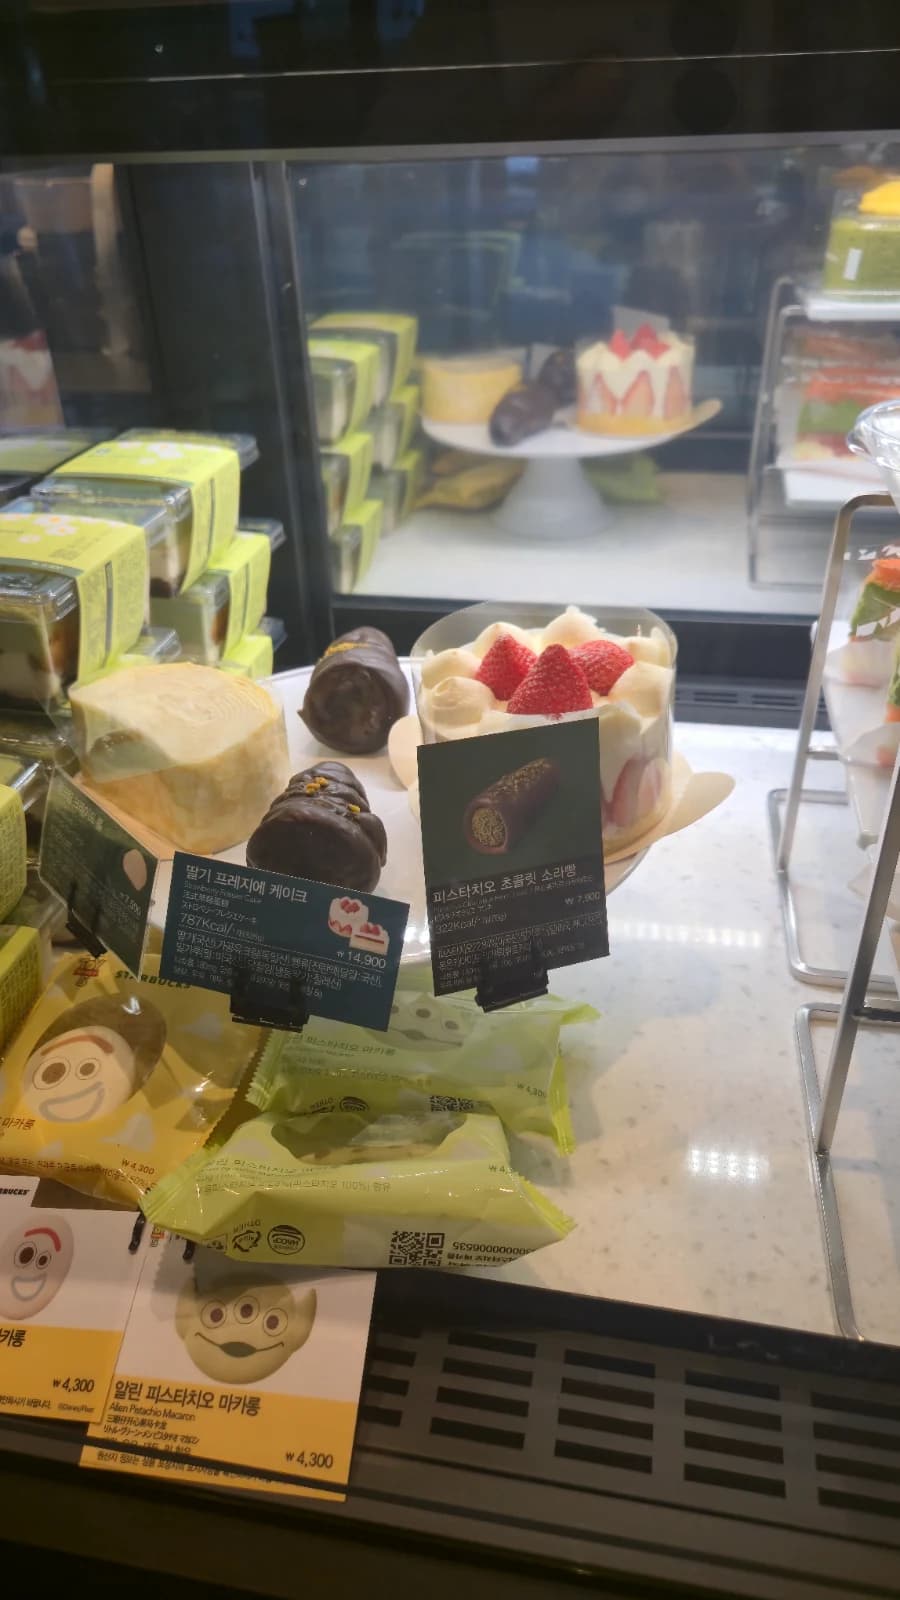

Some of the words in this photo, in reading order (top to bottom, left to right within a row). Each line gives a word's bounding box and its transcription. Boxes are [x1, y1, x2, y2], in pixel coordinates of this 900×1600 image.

[185, 864, 212, 884] 딸기
[213, 872, 266, 896] 프레지에
[268, 883, 309, 903] 케이크
[433, 880, 497, 904] 피스타치오
[541, 863, 577, 882] 소라빵
[114, 1379, 143, 1402] 알린
[146, 1384, 215, 1409] 피스타치오
[218, 1393, 261, 1417] 마카롱
